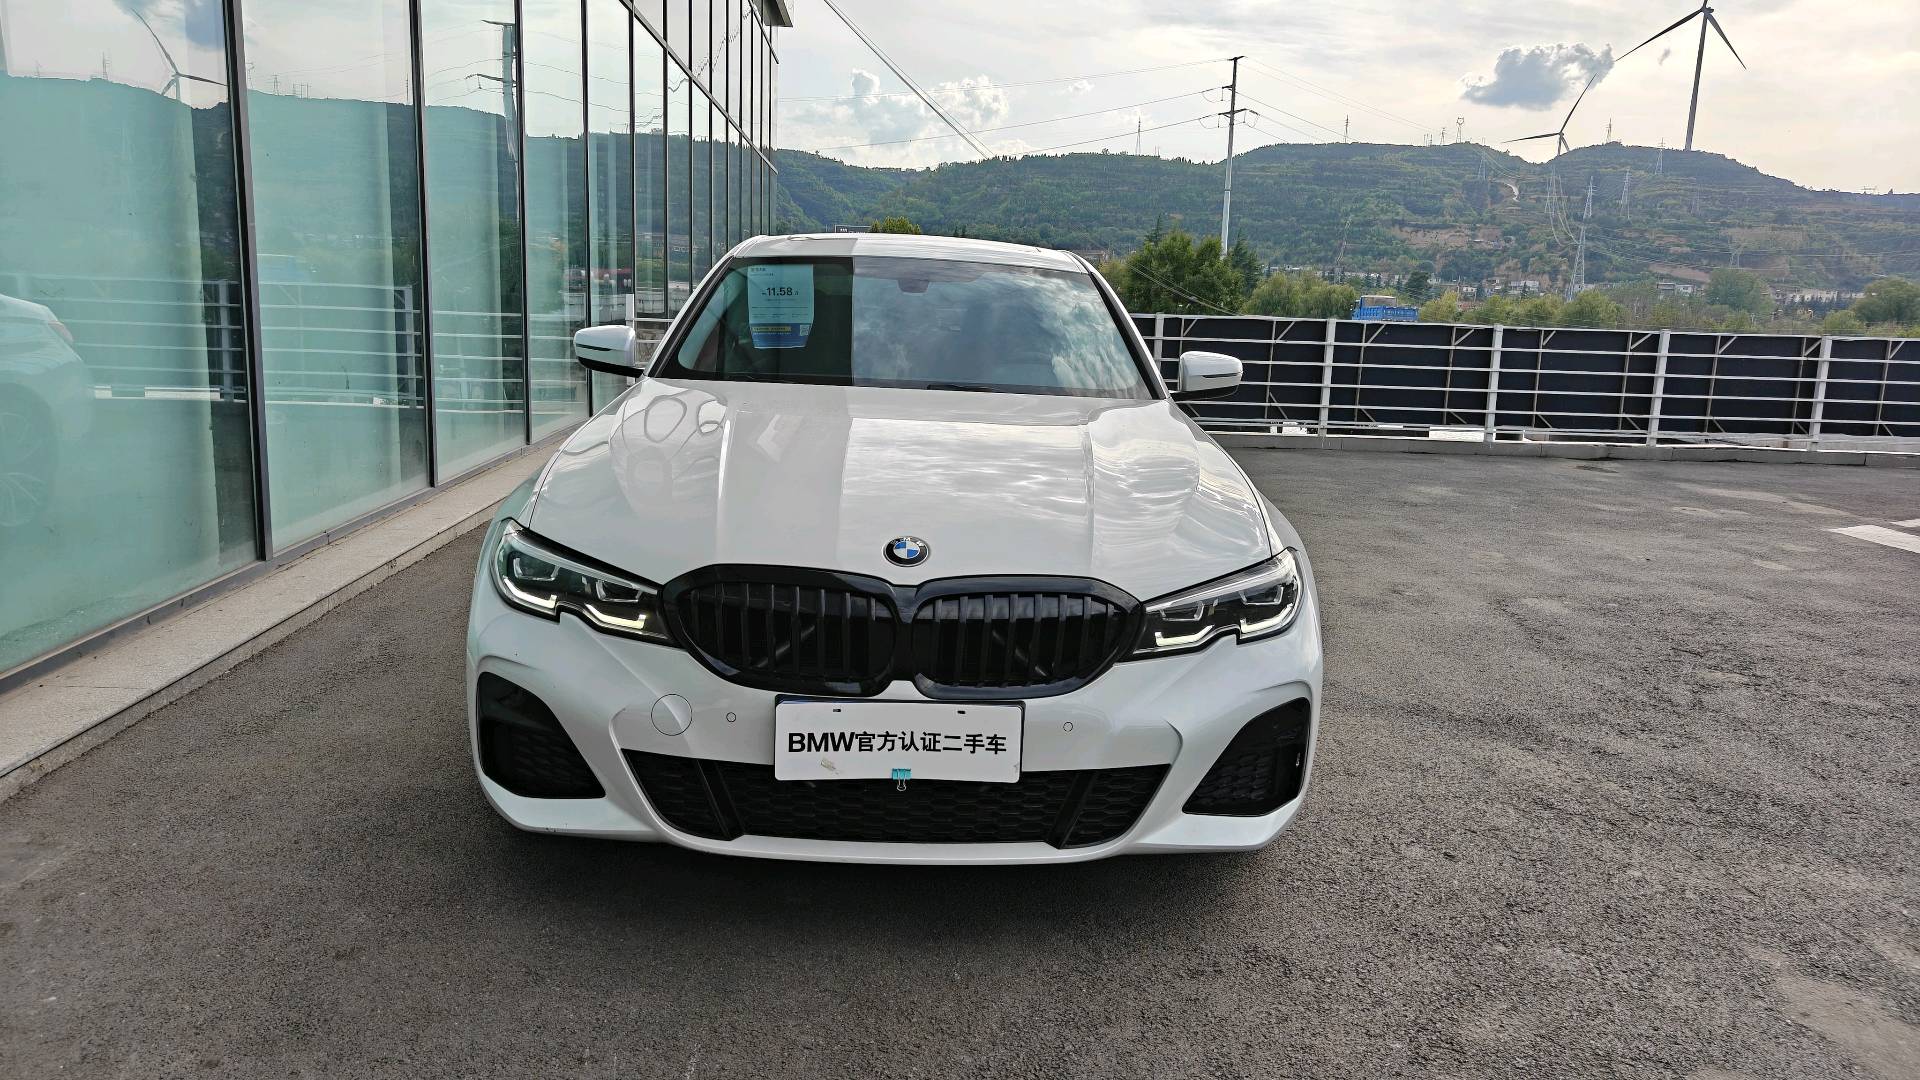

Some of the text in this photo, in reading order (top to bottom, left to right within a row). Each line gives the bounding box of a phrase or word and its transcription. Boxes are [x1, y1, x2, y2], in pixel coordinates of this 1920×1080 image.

[767, 287, 793, 296] 11.58
[788, 731, 1007, 754] BMW官方认证二手车
